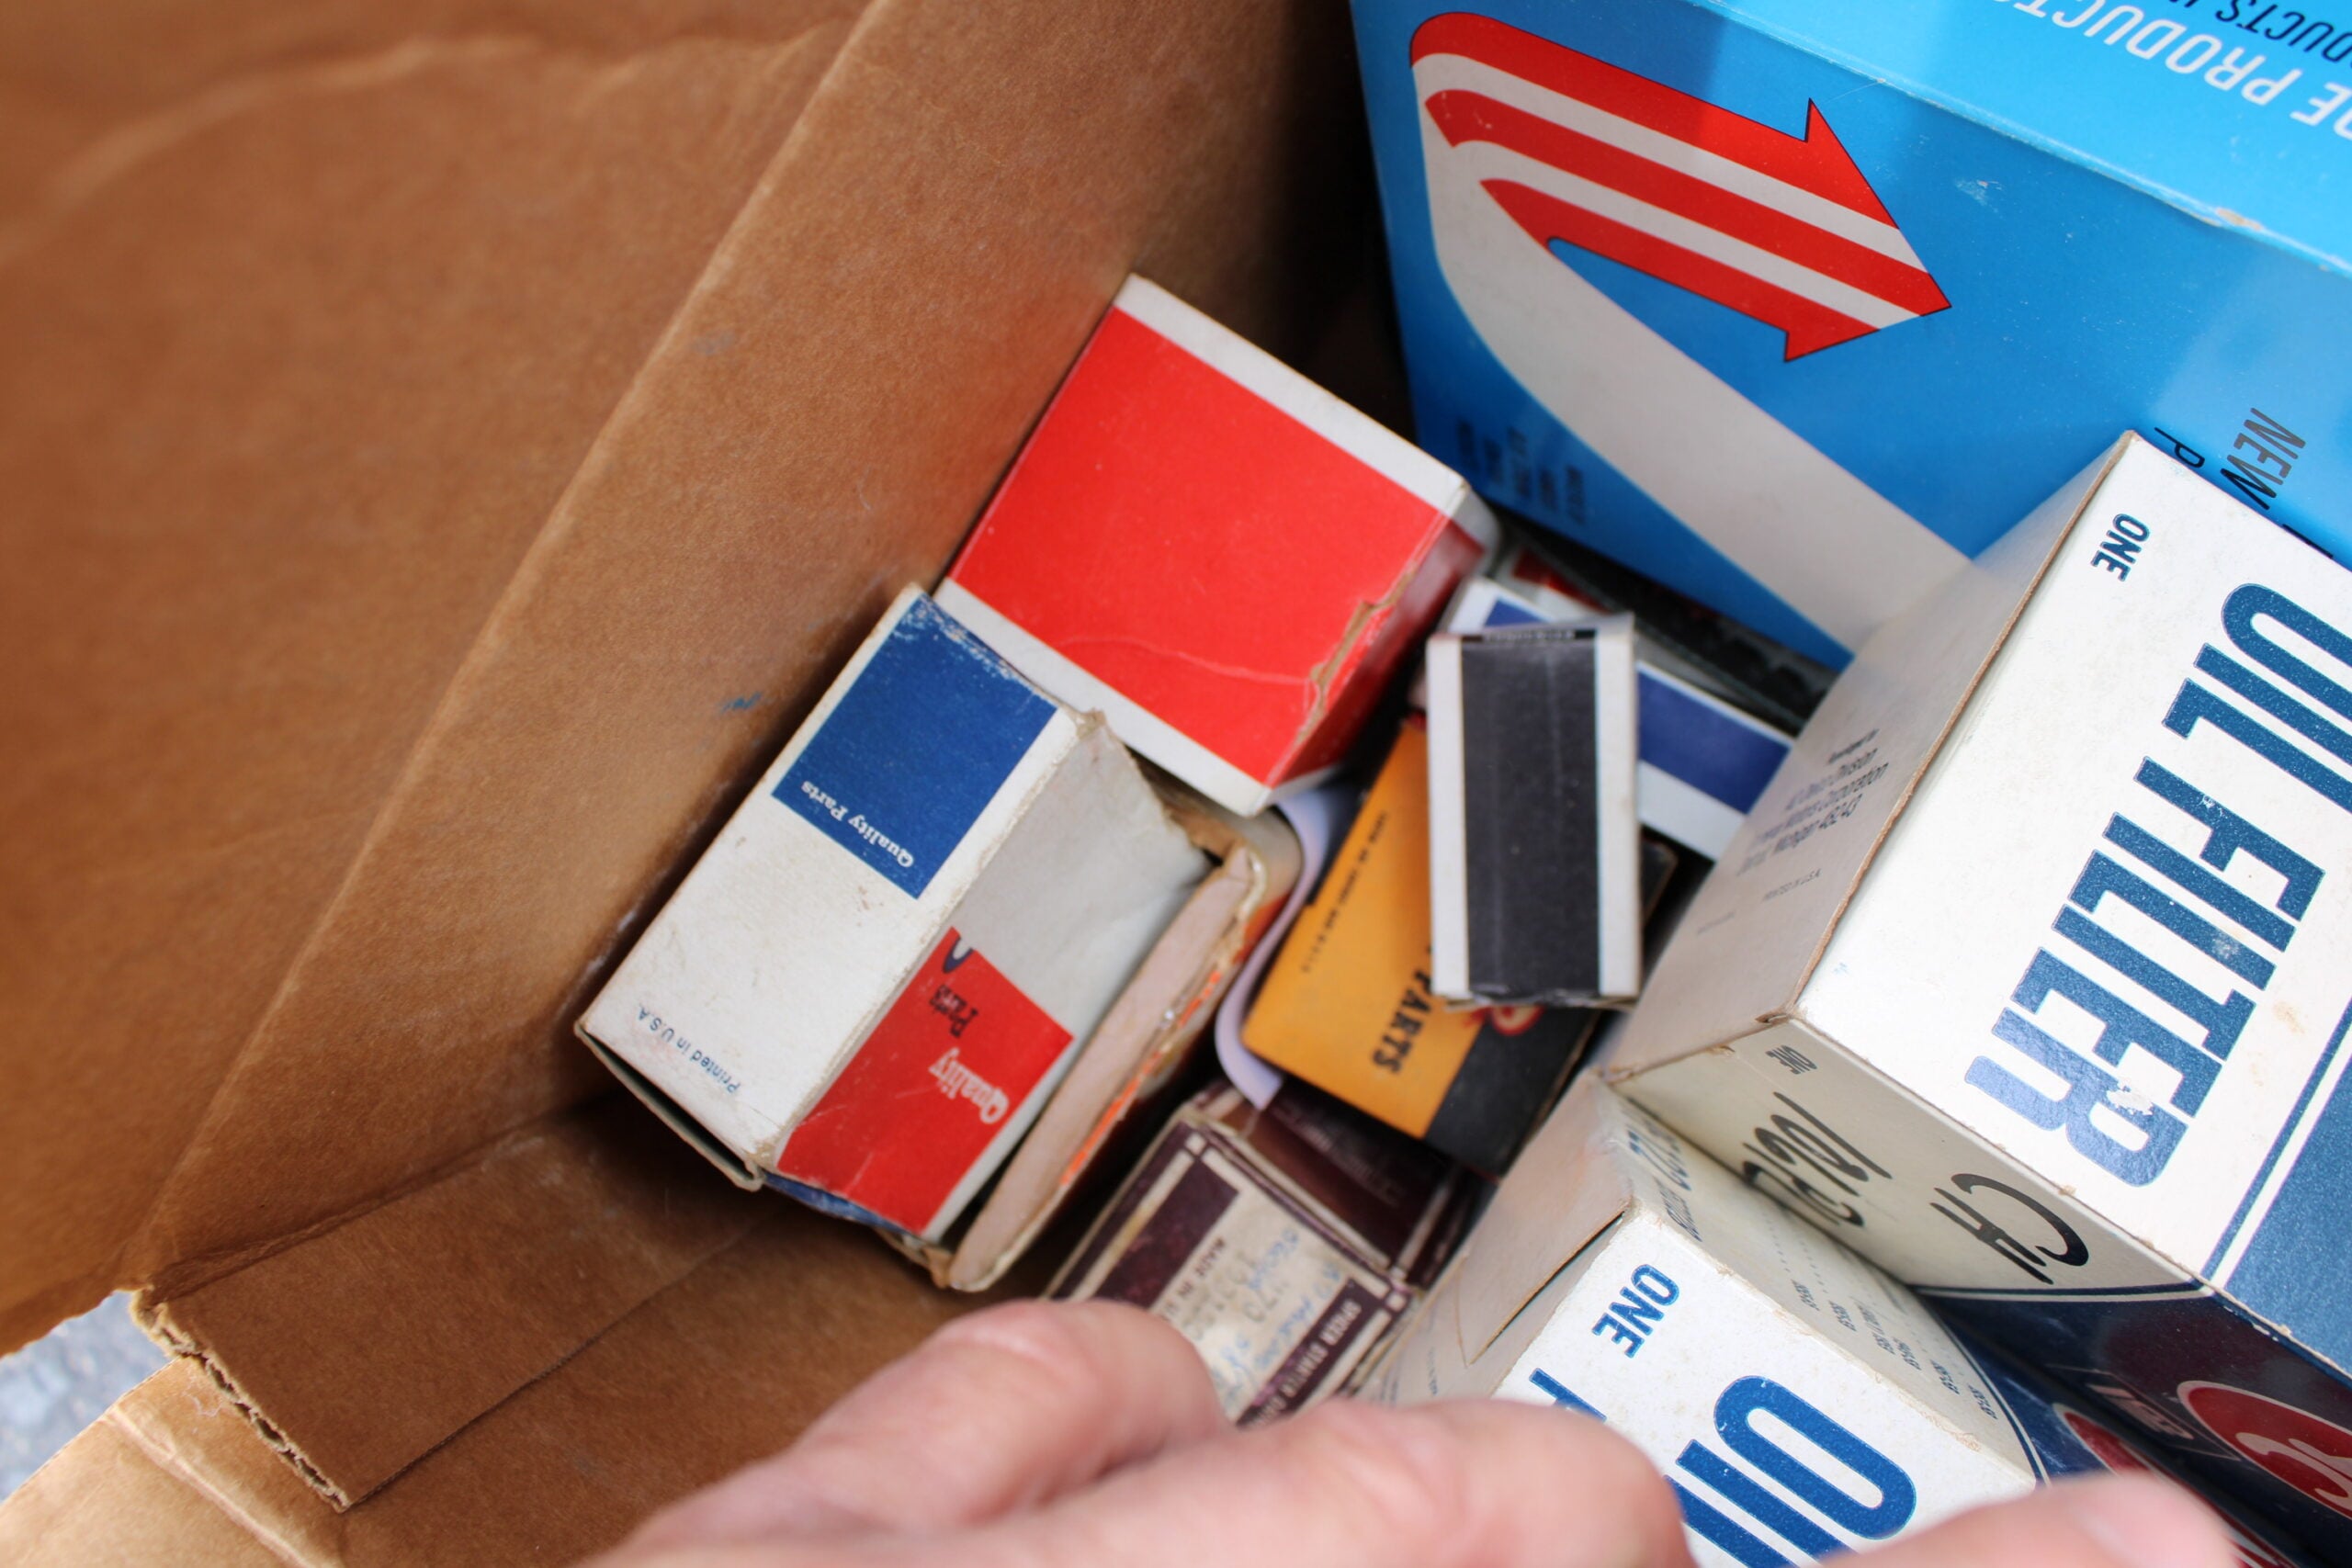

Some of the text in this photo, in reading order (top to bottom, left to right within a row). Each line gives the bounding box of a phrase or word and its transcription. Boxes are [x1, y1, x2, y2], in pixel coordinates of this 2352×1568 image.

[1992, 0, 2302, 106] PRODUCT
[2215, 0, 2352, 68] DUCTS
[2220, 408, 2306, 511] NEW
[2090, 513, 2151, 582] ONE
[2162, 582, 2352, 814] OIL
[801, 781, 914, 868] Quality Parts
[930, 985, 978, 1039] Parts
[1964, 756, 2325, 1188] FILTER
[676, 1036, 692, 1055] in
[689, 1049, 741, 1093] Printed
[928, 1047, 1010, 1124] Quality
[1765, 1044, 1818, 1075] ONE
[1928, 1173, 2089, 1285] CH
[1591, 1263, 1680, 1359] ONE
